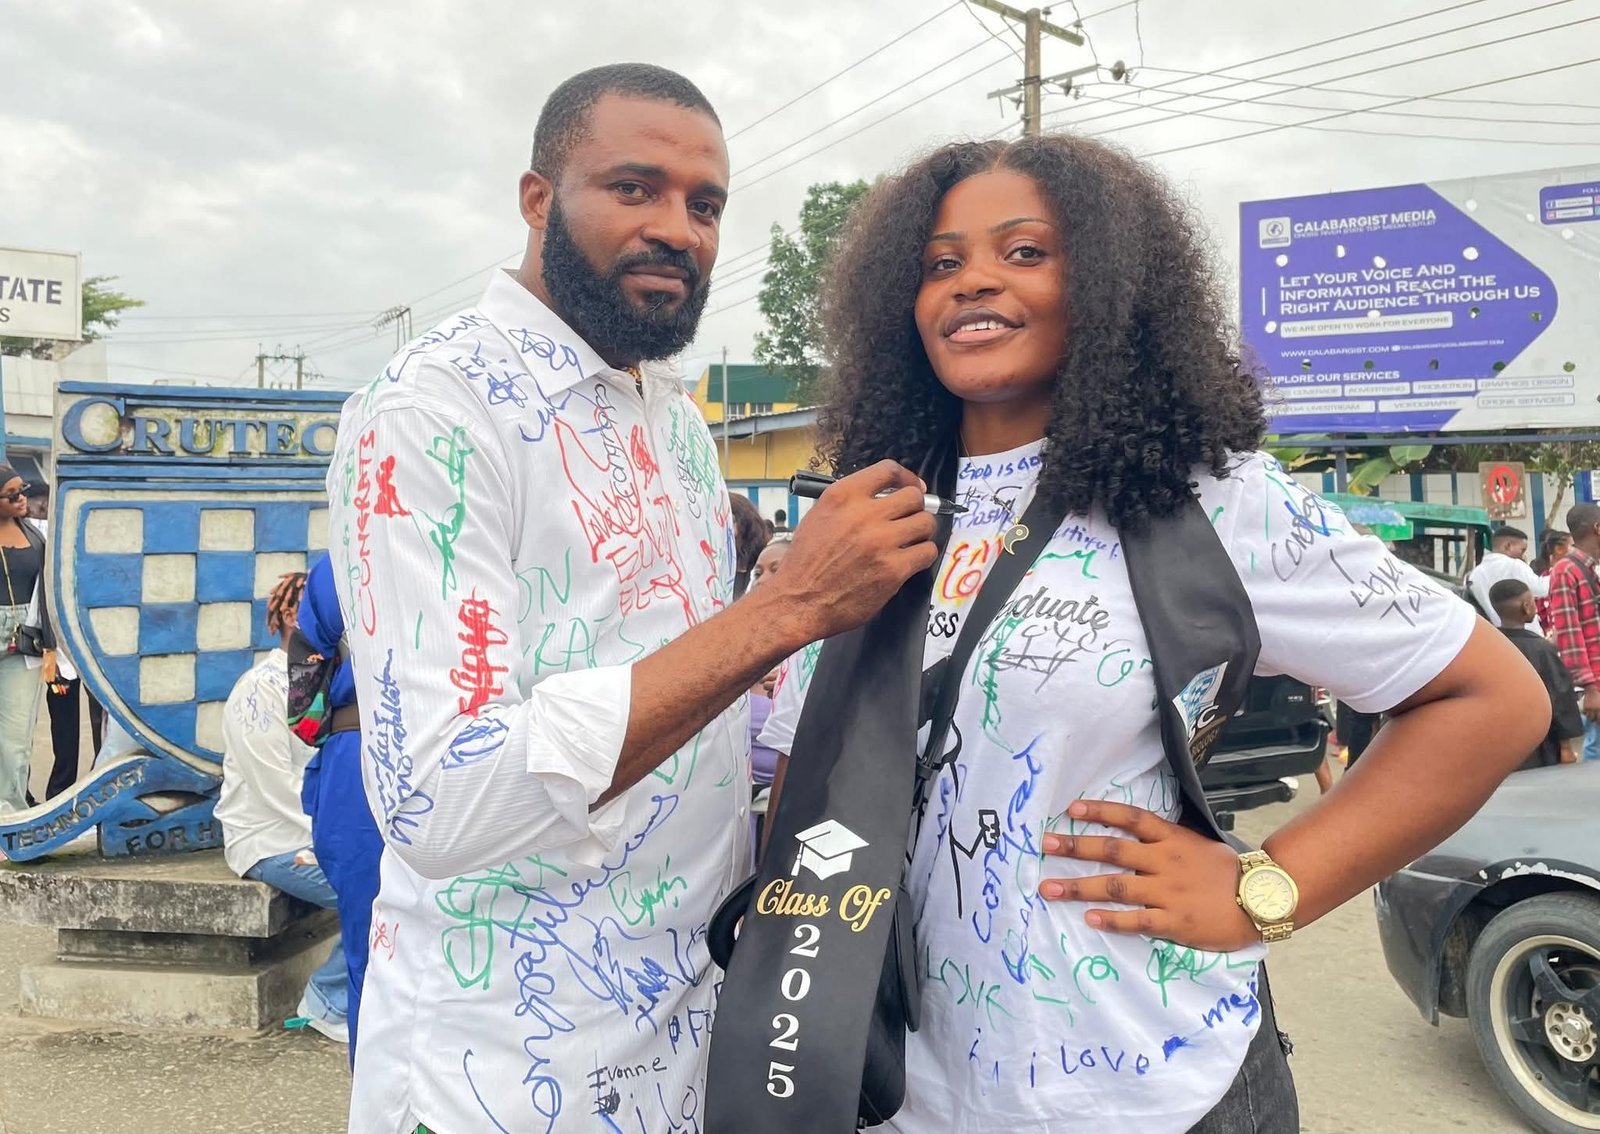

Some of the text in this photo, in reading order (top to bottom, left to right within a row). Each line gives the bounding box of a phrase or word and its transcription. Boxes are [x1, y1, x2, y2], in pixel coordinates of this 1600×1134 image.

[1294, 210, 1436, 233] CALABARGIST MEDIA
[1300, 324, 1316, 332] ARE
[1318, 323, 1341, 331] OPEN
[1342, 322, 1354, 330] TO
[1356, 320, 1382, 328] WORK
[1383, 318, 1400, 327] FOR
[1402, 316, 1449, 326] EVERYONE
[1281, 346, 1389, 358] WWW.CALABARGIST.COM
[1316, 372, 1340, 382] OUR
[1343, 370, 1400, 382] SERVICES
[958, 462, 992, 480] GOD
[997, 463, 1014, 476] IS
[3, 766, 145, 851] TECHNOLOGY
[126, 825, 189, 855] FOR
[756, 878, 891, 932] Class Of
